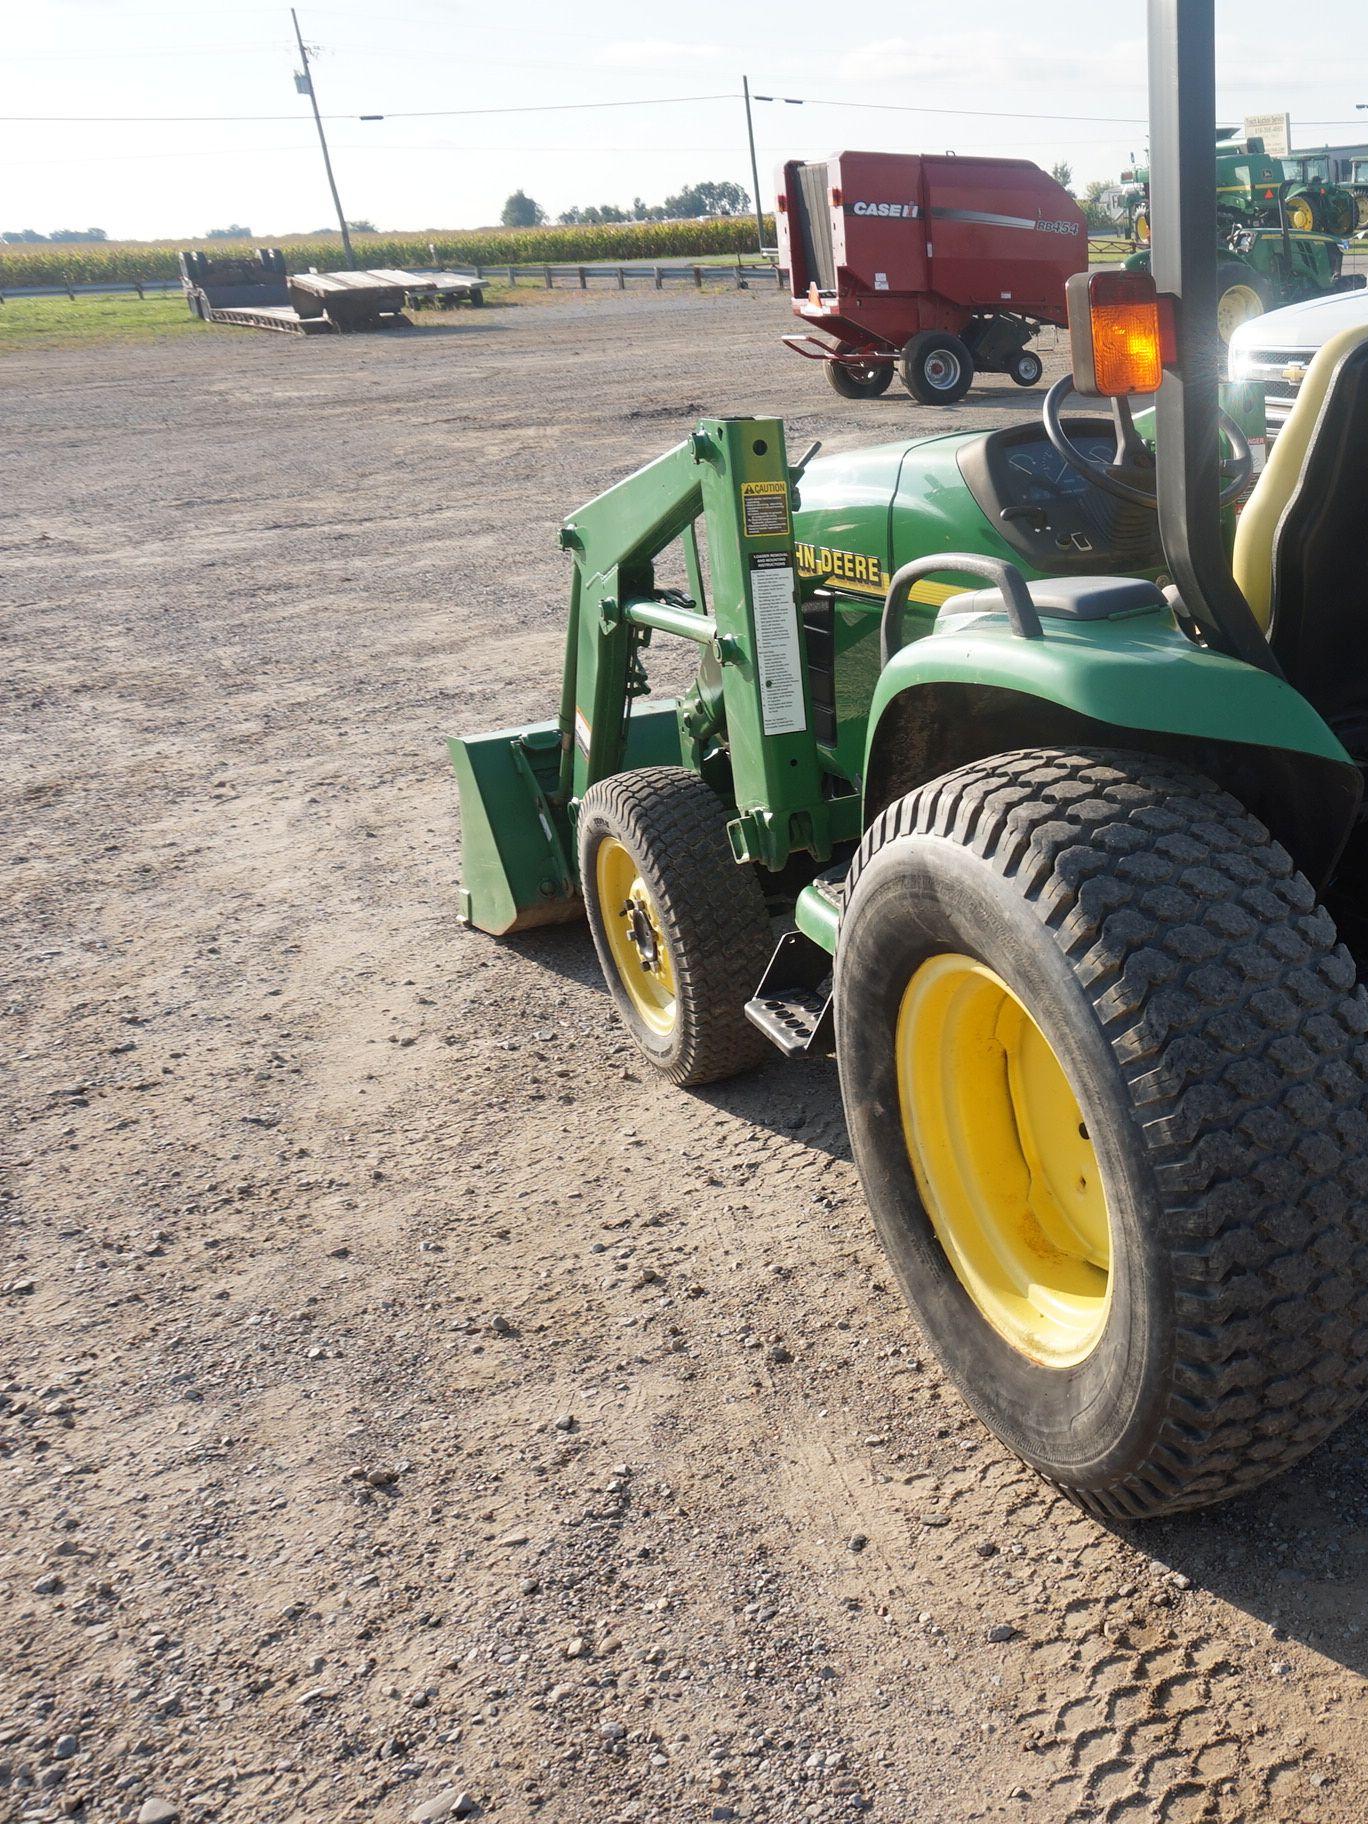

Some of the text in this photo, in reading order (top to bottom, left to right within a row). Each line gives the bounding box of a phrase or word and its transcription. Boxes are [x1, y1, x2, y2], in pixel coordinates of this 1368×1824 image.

[853, 201, 902, 217] CASE
[1035, 220, 1079, 235] RB454
[754, 483, 785, 494] CAUTION
[821, 549, 880, 582] DEERE
